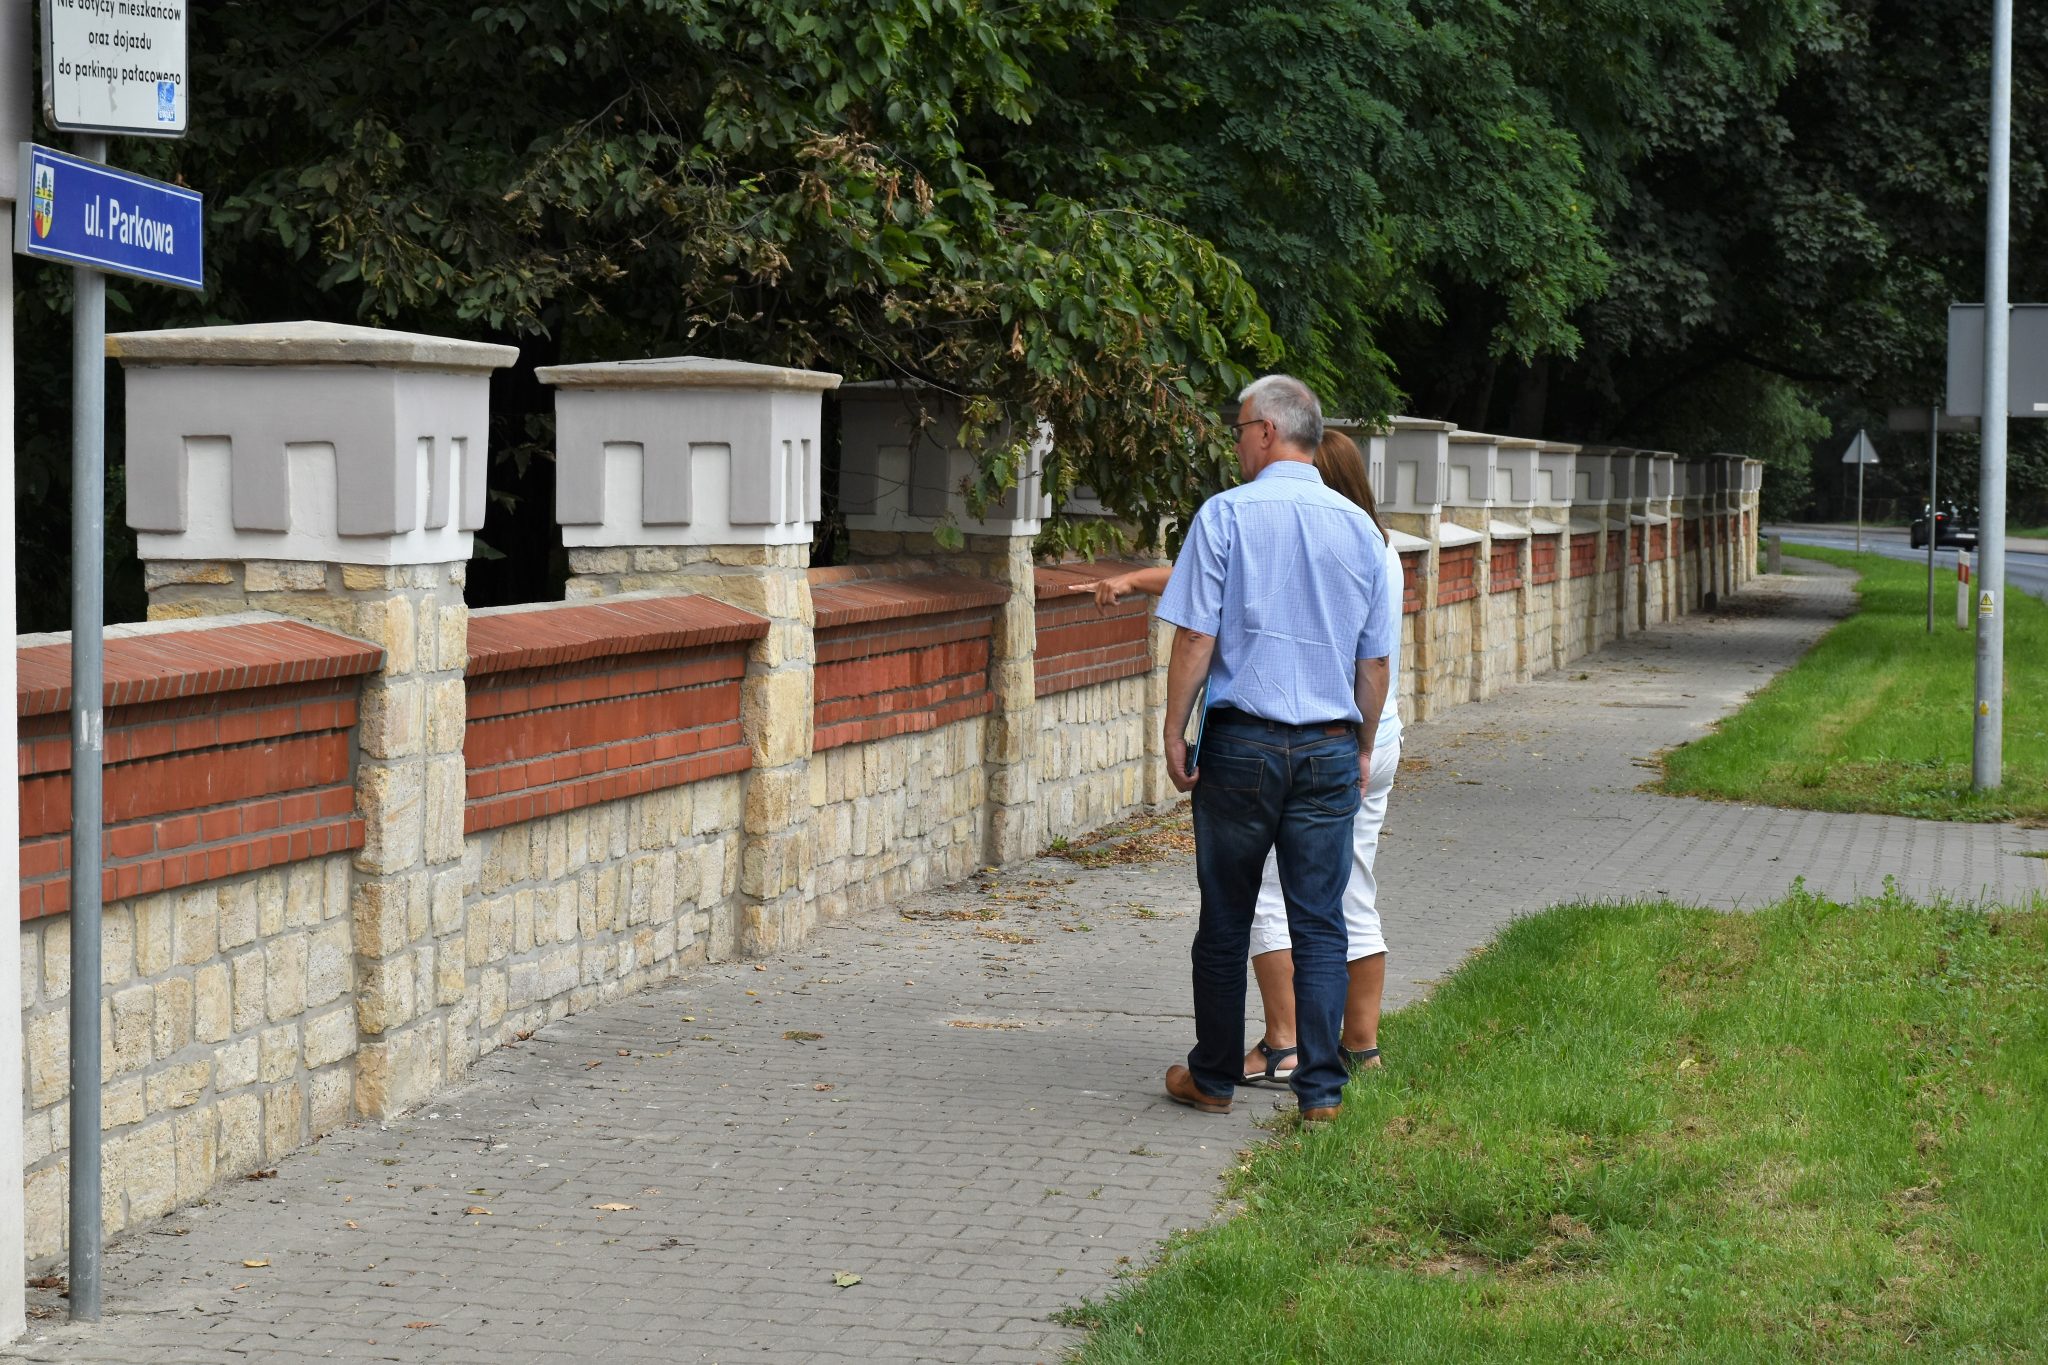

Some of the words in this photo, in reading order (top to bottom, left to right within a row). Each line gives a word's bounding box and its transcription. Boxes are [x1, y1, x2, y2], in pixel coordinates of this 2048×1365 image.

[78, 0, 114, 18] dotyczy
[119, 0, 181, 20] mieszkańców
[88, 31, 109, 46] oraz
[113, 29, 152, 52] dojazdu
[58, 57, 71, 75] do
[75, 60, 118, 84] parkingu
[85, 194, 104, 238] ul.
[109, 198, 174, 255] Parkowa
